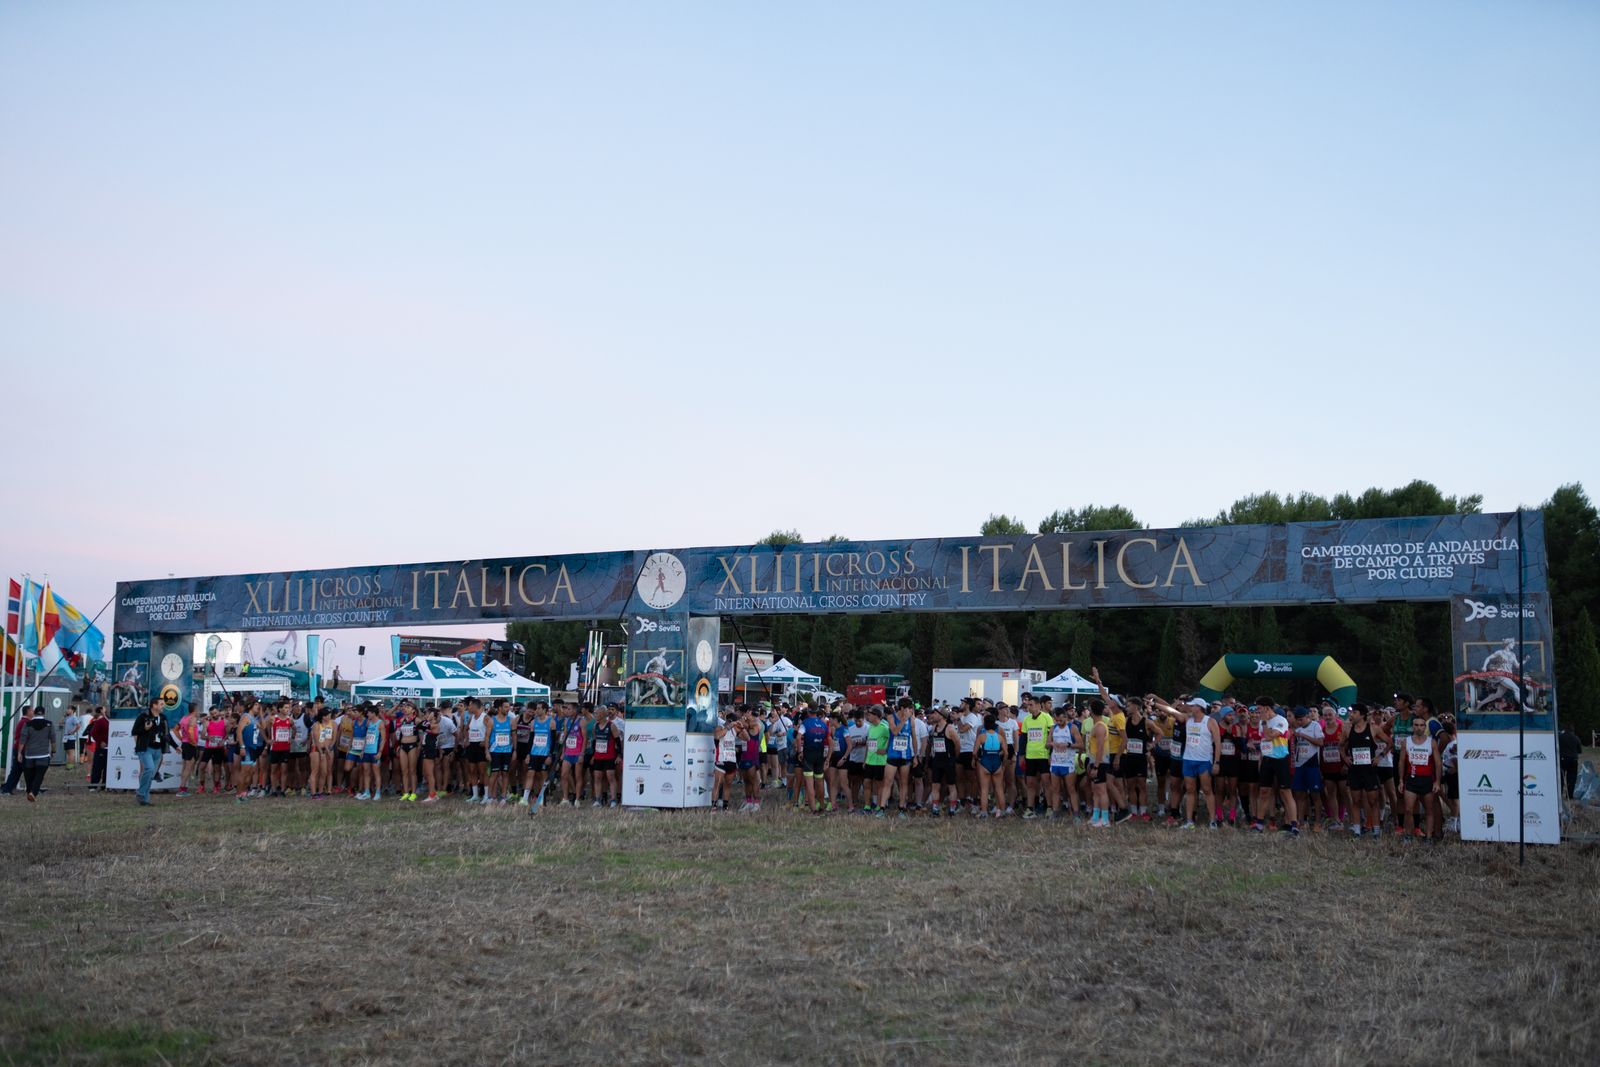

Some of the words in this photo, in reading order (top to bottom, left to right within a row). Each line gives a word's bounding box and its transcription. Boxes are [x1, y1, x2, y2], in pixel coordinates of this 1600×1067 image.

[1301, 543, 1402, 558] CAMPEONATO
[1404, 542, 1424, 554] DE
[1427, 536, 1519, 553] ANDALUCÍA
[825, 550, 915, 576] CROSS
[960, 533, 1207, 593] ITÁLICA
[1334, 557, 1353, 569] DE
[1355, 555, 1410, 568] CAMPO
[1413, 555, 1424, 567] A
[1427, 550, 1485, 566] TRAVÉS
[715, 552, 823, 595] XLIII
[1367, 568, 1397, 580] POR
[1399, 566, 1454, 579] CLUBES
[319, 574, 382, 598] CROSS
[411, 560, 579, 610] ITÁLICA
[826, 576, 950, 592] INTERNACIONAL
[122, 596, 166, 606] CAMPEONATO
[167, 595, 176, 604] DE
[176, 592, 216, 603] ANDALUCÍA
[243, 577, 318, 615] XLIII
[319, 596, 404, 611] INTERNACIONAL
[714, 596, 817, 610] INTERNATIONAL
[819, 594, 859, 608] CROSS
[861, 593, 927, 607] COUNTRY
[135, 605, 144, 614] DE
[145, 603, 169, 613] CAMPO
[169, 603, 175, 612] A
[176, 602, 201, 612] TRAVÉS
[1500, 602, 1535, 610] Diputaión
[1500, 609, 1535, 618] Sevlla
[149, 613, 163, 621] POR
[163, 611, 187, 620] CLUBES
[242, 613, 313, 627] INTERNATIONAL
[314, 612, 342, 624] CROSS
[343, 610, 389, 623] COUNTRY
[392, 686, 421, 696] Sevilla
